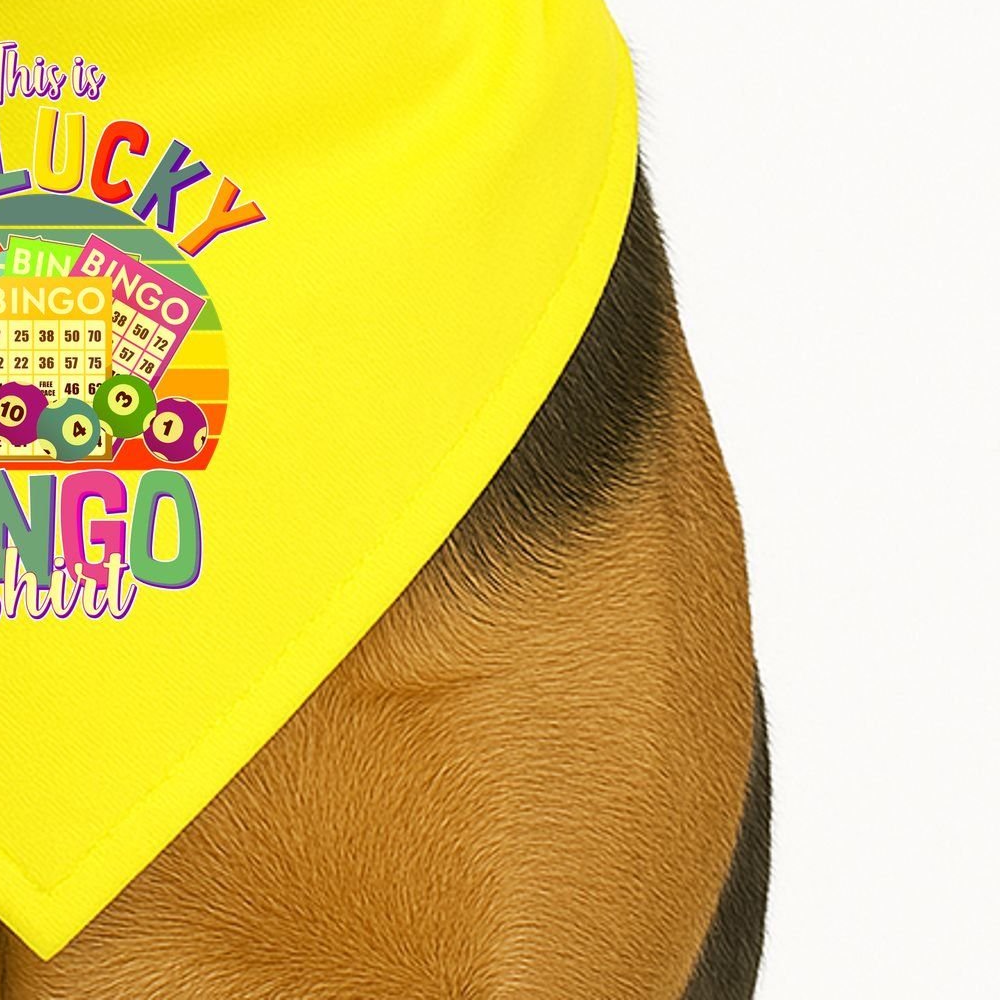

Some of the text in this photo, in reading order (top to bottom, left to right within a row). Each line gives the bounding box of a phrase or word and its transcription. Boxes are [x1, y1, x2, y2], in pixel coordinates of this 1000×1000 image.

[72, 55, 106, 102] is
[80, 247, 190, 326] BINGO
[13, 329, 30, 343] 25
[38, 329, 55, 343] 38
[64, 329, 80, 343] 50
[87, 329, 102, 343] 70
[132, 323, 150, 341] 50
[152, 335, 169, 352] 72
[13, 356, 29, 370] 22
[38, 356, 55, 370] 36
[64, 356, 79, 370] 57
[87, 356, 102, 370] 75
[118, 346, 156, 375] 57 78
[39, 380, 53, 388] FREE
[64, 382, 80, 396] 46
[115, 390, 133, 408] 3
[0, 401, 25, 422] 10
[72, 420, 87, 438] 4
[162, 418, 174, 437] 1
